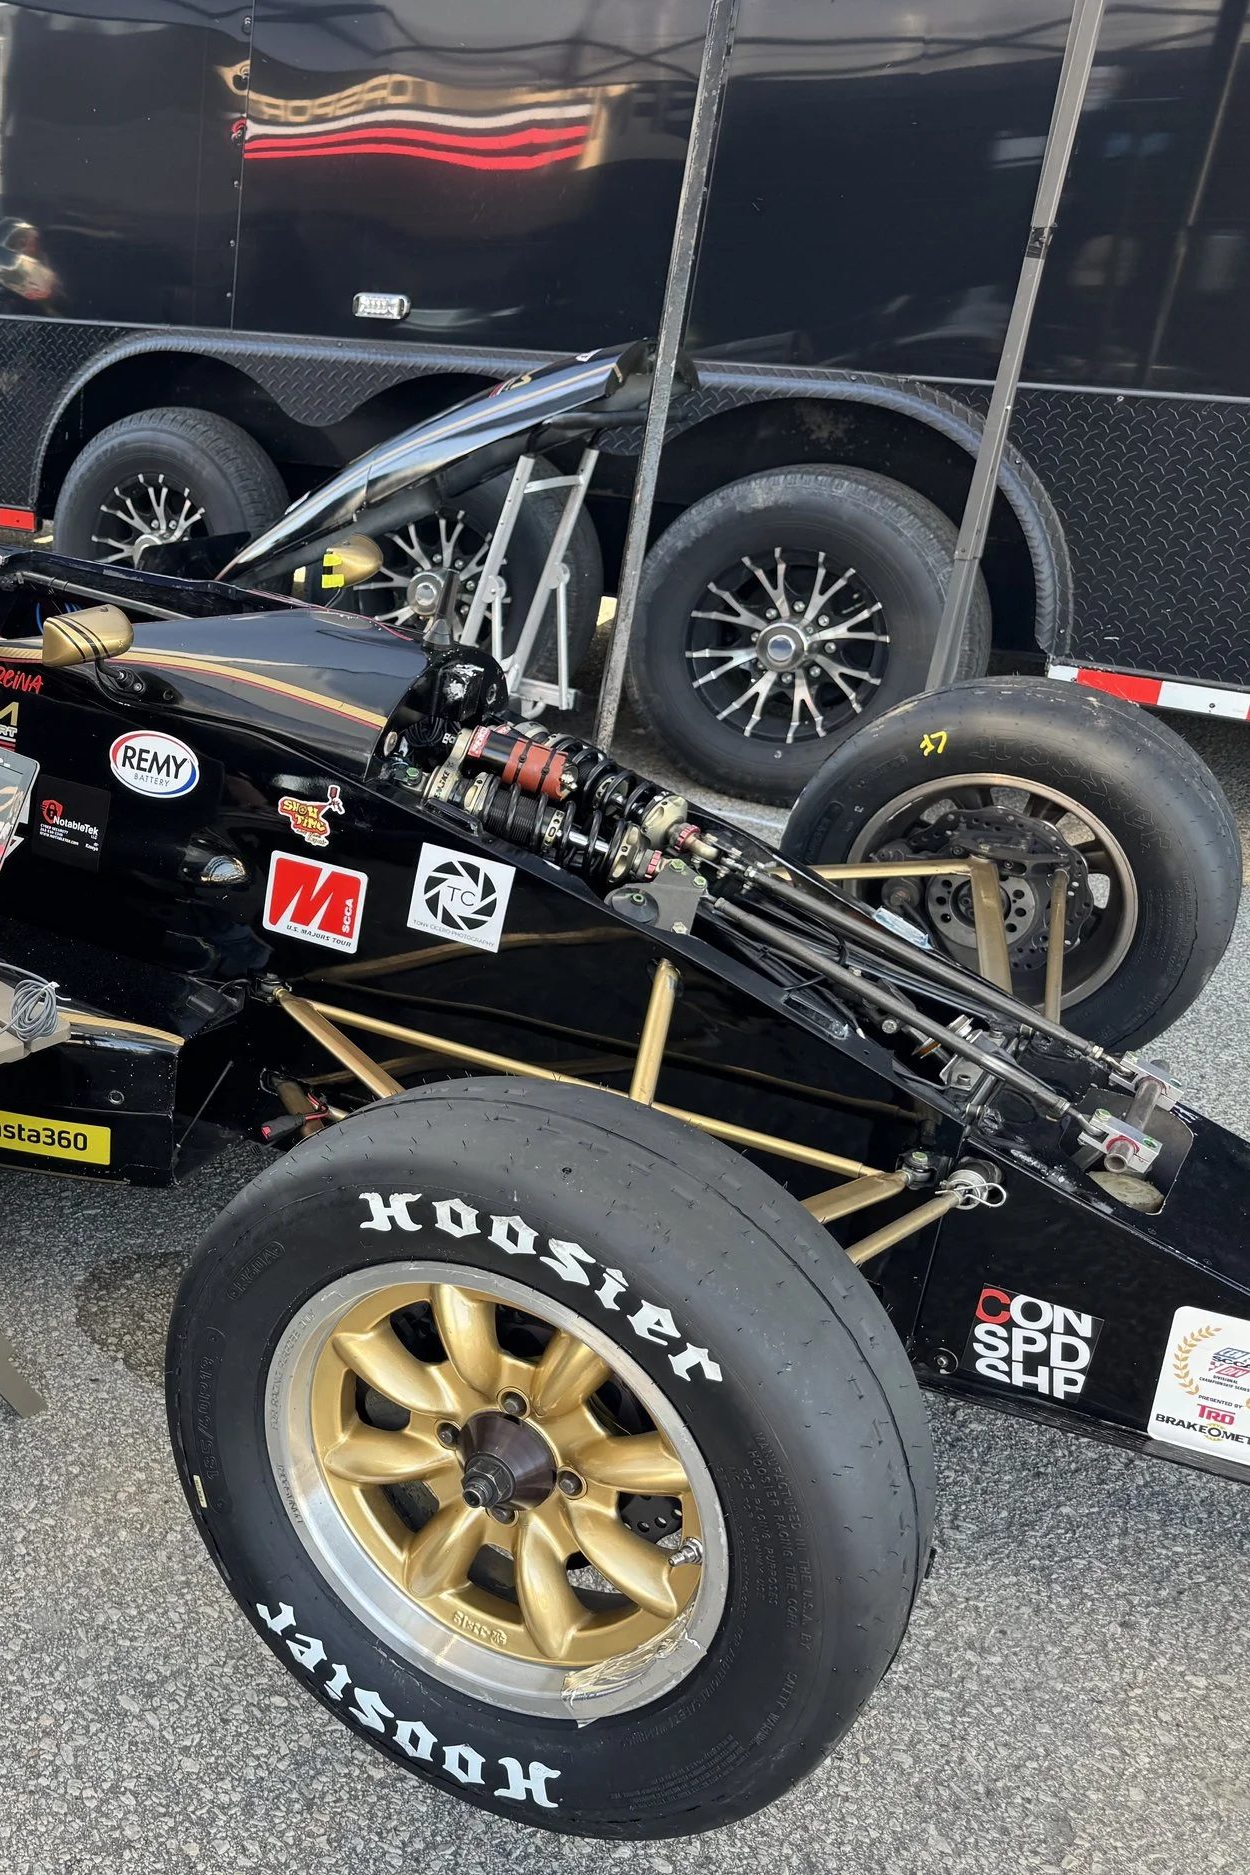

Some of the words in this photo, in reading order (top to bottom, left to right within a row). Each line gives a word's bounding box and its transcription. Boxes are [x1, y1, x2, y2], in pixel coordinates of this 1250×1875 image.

[121, 744, 188, 780] REMY
[133, 772, 170, 788] BATTERY
[282, 799, 319, 819] SHOW
[53, 815, 99, 836] NotableTek
[447, 885, 476, 906] TC
[342, 898, 354, 934] SCCA
[286, 924, 299, 933] U.S.
[301, 927, 331, 942] MAJORS
[332, 937, 352, 948] TOUR
[413, 919, 429, 928] TONY
[429, 923, 451, 934] CICERO
[451, 929, 495, 948] PHOTOGRAPHY
[358, 1191, 723, 1383] Hoosier
[975, 1288, 1092, 1338] CON
[972, 1322, 1091, 1370] SPD
[975, 1357, 1086, 1400] SHP
[1199, 1376, 1234, 1389] CHAMPIONSHIP
[1212, 1374, 1238, 1385] DIVISIONAL
[1198, 1394, 1233, 1407] PRESENTED
[748, 1450, 781, 1507] HOOSIER
[773, 1513, 793, 1558] RACING
[785, 1563, 799, 1592] TIRE
[799, 1559, 813, 1586] THE
[256, 1601, 562, 1809] Hoosier
